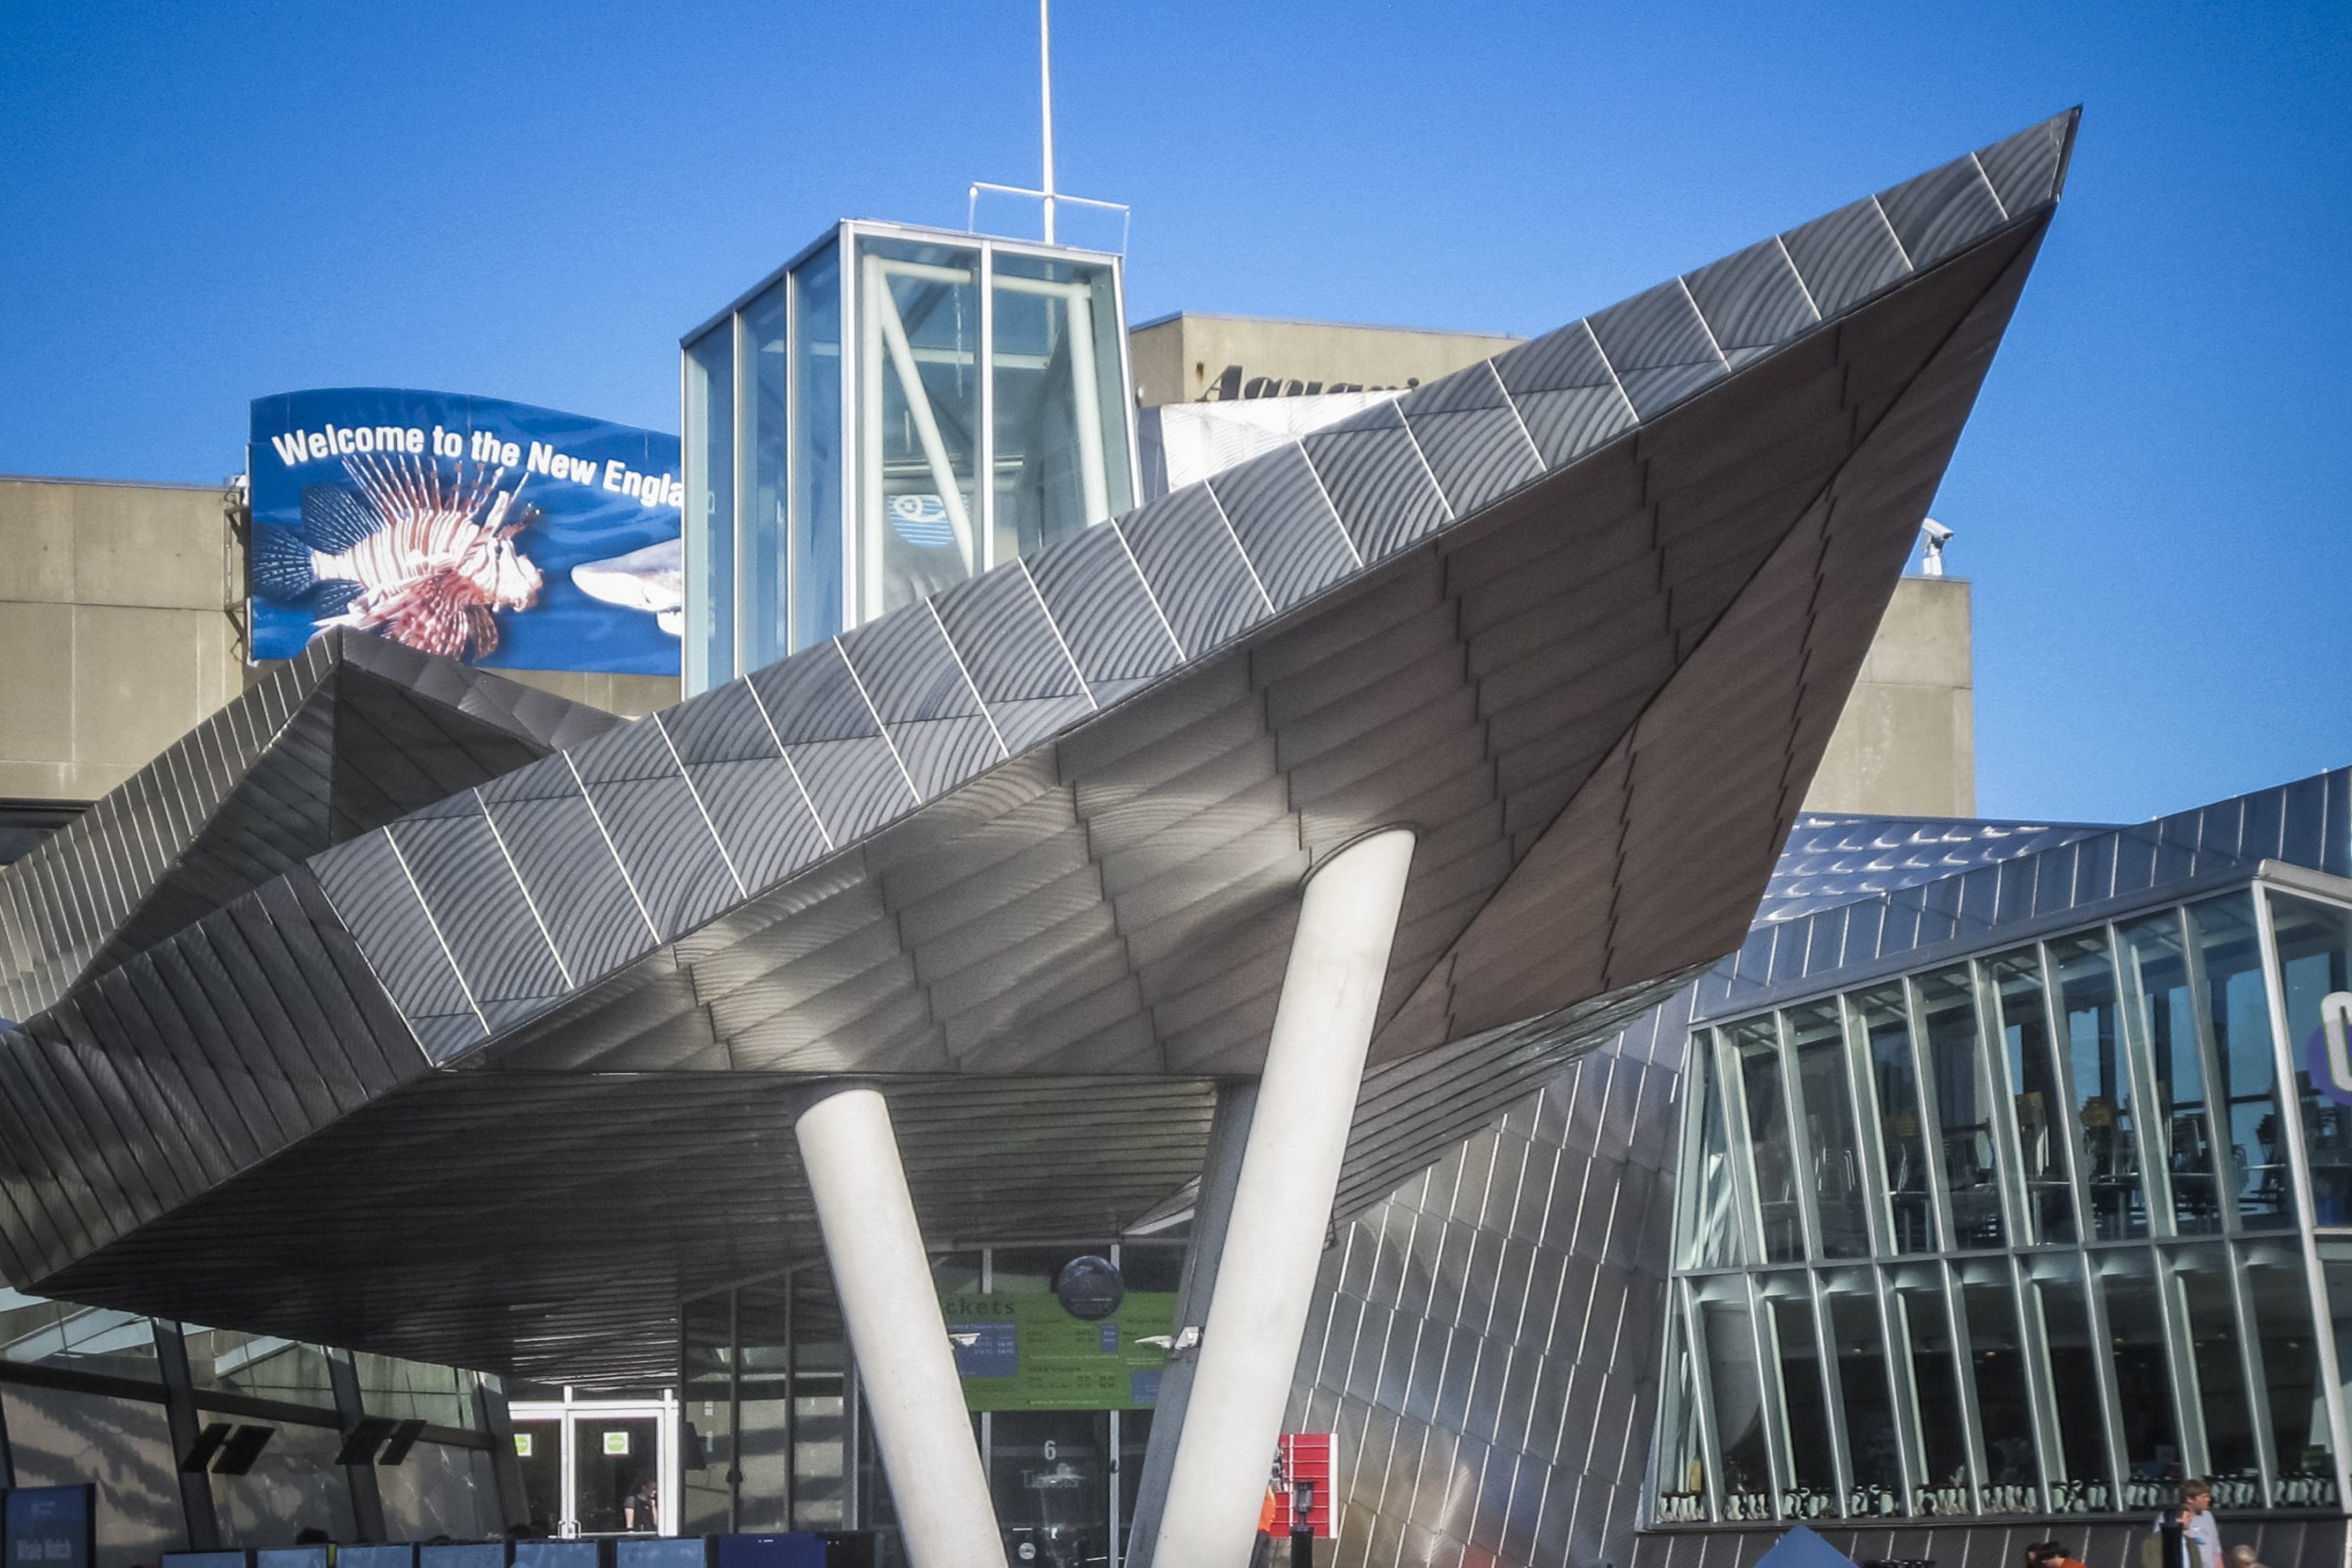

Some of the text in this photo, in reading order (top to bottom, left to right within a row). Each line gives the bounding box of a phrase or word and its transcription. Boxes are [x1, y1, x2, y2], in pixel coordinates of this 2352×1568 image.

[271, 423, 683, 508] Welcome to the New Engla
[946, 1297, 1014, 1314] ckets
[1044, 1439, 1057, 1461] 6
